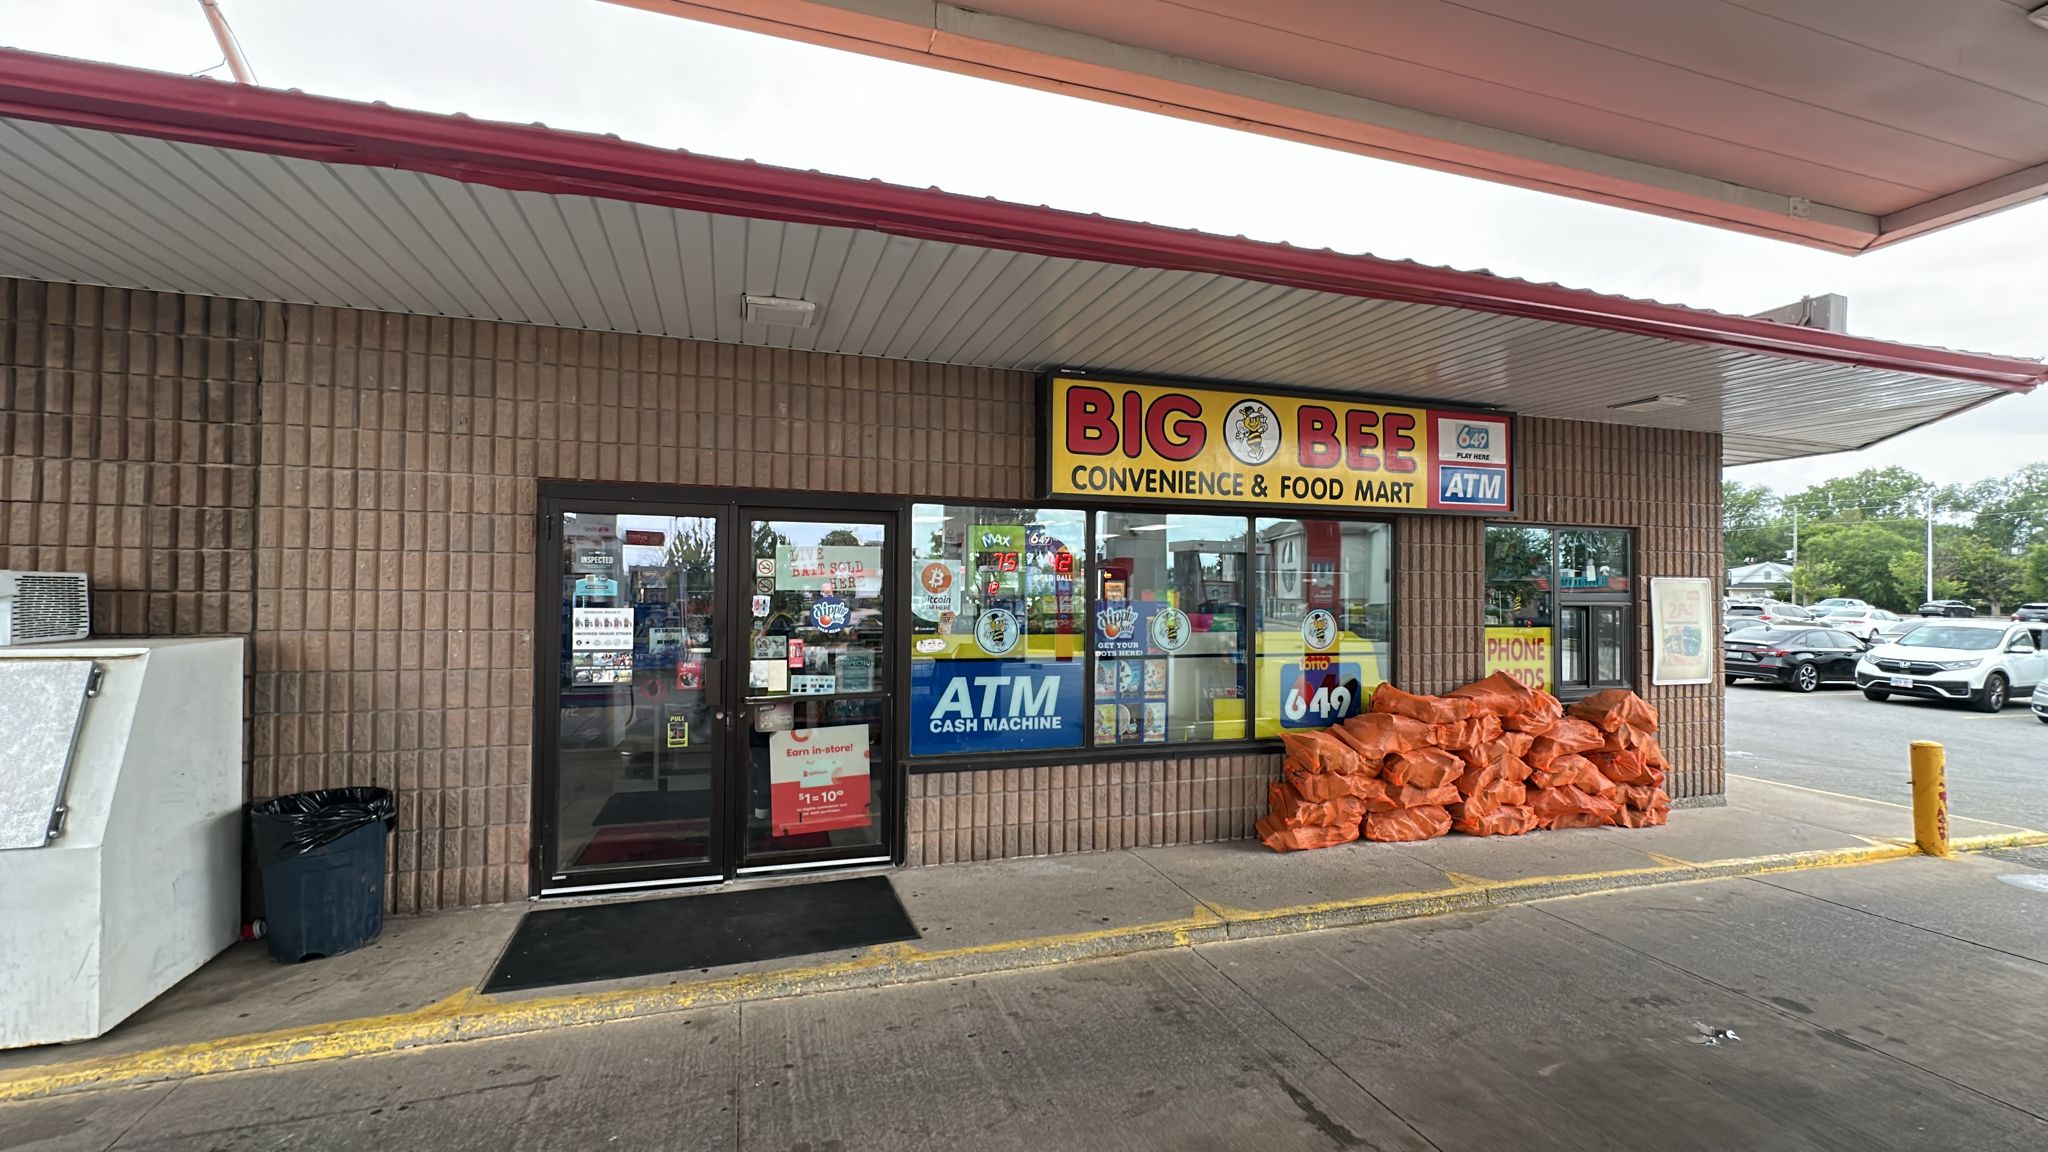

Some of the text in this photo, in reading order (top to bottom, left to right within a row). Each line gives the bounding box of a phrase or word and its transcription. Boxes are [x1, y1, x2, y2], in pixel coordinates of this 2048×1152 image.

[1066, 385, 1418, 473] BIG BEE
[1457, 425, 1488, 448] 649
[1071, 465, 1414, 504] CONVENIENCE & FOOD MART
[1445, 473, 1501, 499] ATM
[982, 533, 1010, 547] MAX
[1030, 532, 1050, 545] 649
[580, 556, 614, 564] INSPECTED
[789, 547, 824, 561] LIVE
[994, 553, 1017, 572] 75
[791, 561, 864, 577] BAIT SOLD
[829, 576, 865, 589] HERE
[1487, 637, 1545, 662] PHONE
[1299, 657, 1329, 670] LOTTO
[930, 675, 1061, 719] ATM
[1284, 687, 1351, 721] 649
[930, 716, 1062, 733] CASH MACHINE
[786, 743, 854, 757] Earn in-store!
